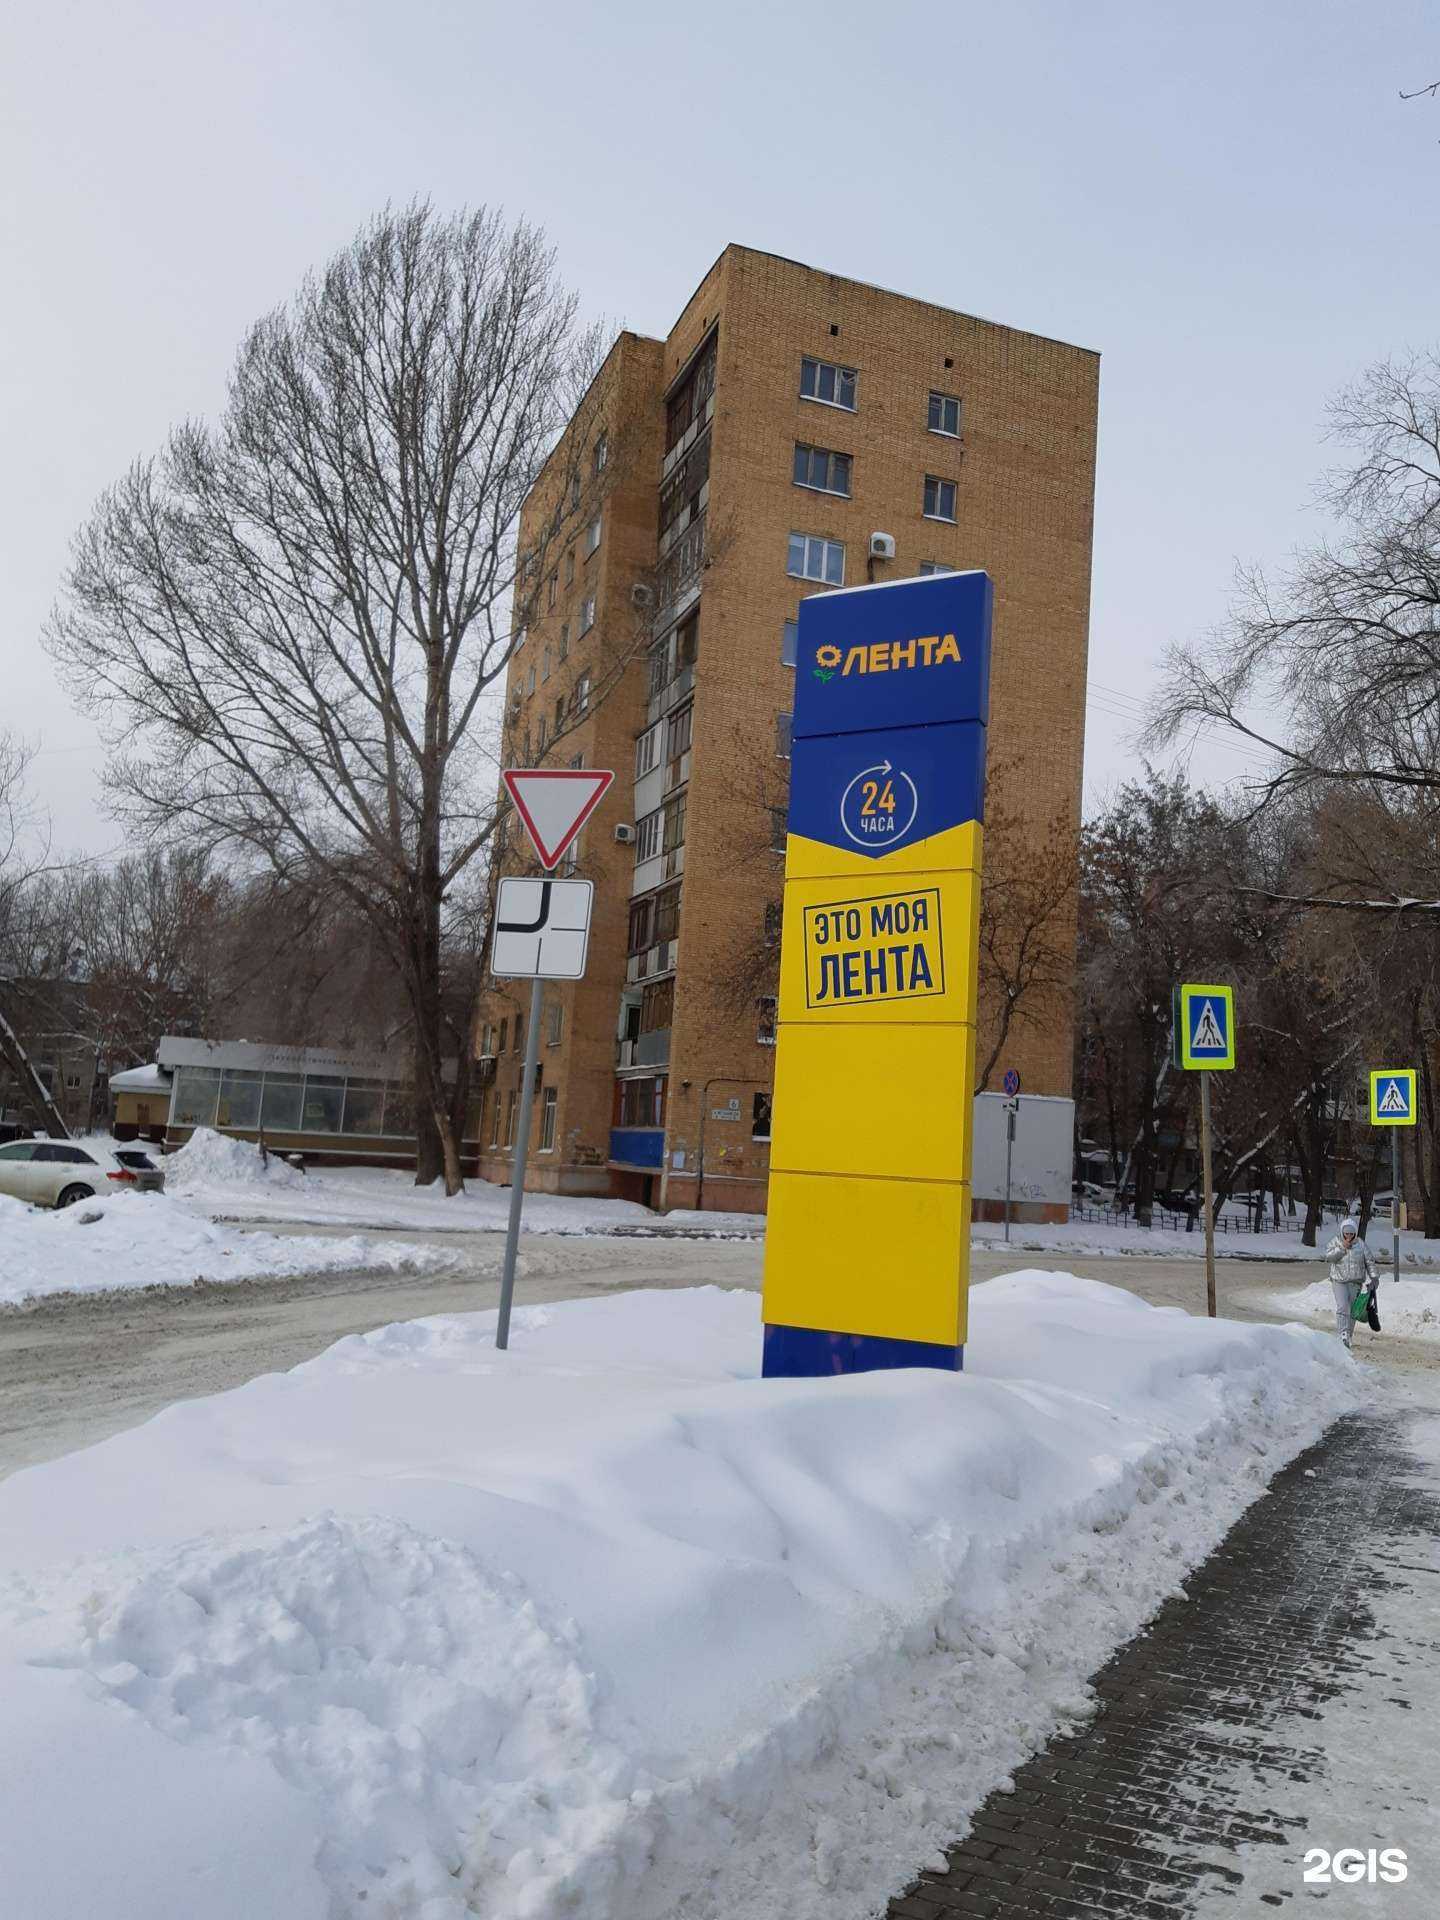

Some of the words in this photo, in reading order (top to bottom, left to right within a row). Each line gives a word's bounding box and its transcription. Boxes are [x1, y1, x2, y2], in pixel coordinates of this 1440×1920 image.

[842, 634, 961, 676] ЛЕНТА
[861, 780, 896, 816] 24
[860, 816, 895, 833] ЧАСА
[814, 908, 861, 945] ЭТО
[870, 898, 929, 937] МОЯ
[816, 943, 933, 1000] ЛЕНТА
